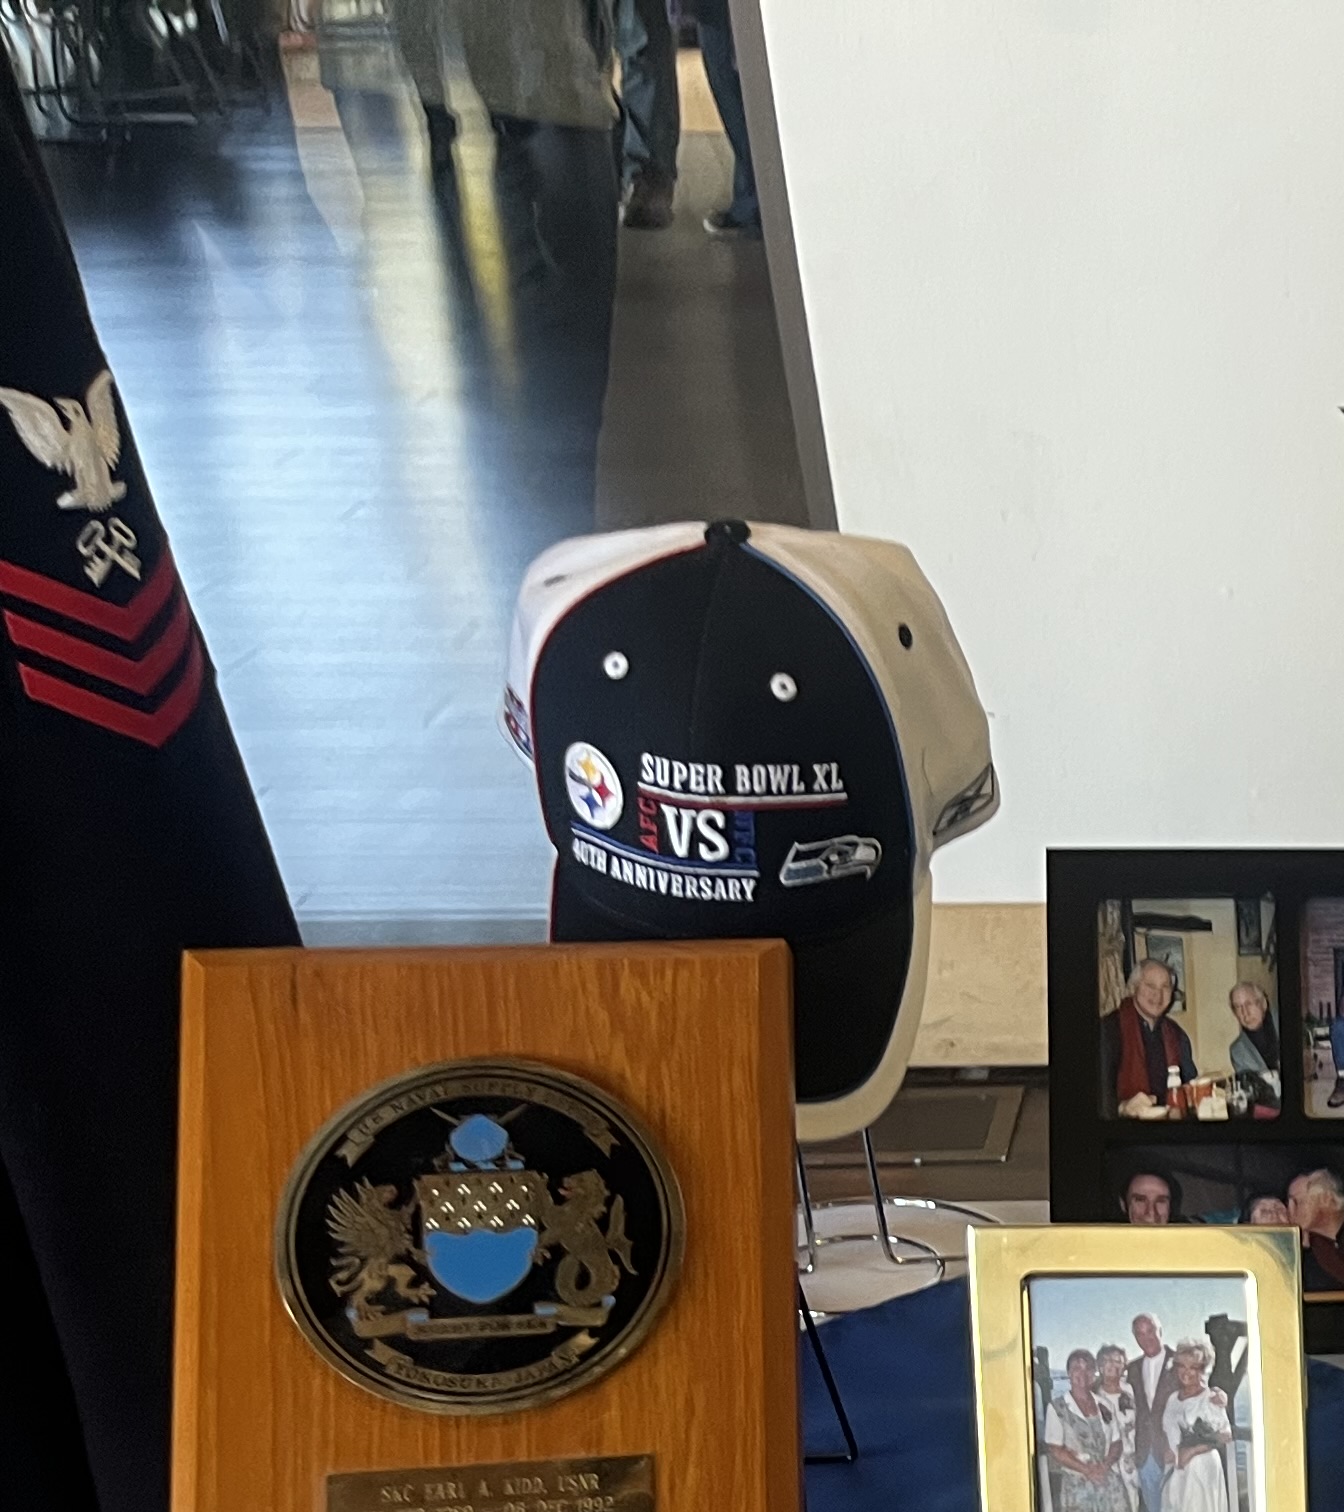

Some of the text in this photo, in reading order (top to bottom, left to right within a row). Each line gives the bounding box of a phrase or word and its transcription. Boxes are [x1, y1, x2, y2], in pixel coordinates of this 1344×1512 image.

[641, 752, 844, 794] SUPER BOWL XL
[637, 797, 659, 855] AFC
[660, 803, 730, 862] VS
[573, 837, 757, 902] 40TH ANNIVERSARY
[424, 1482, 466, 1500] EARL
